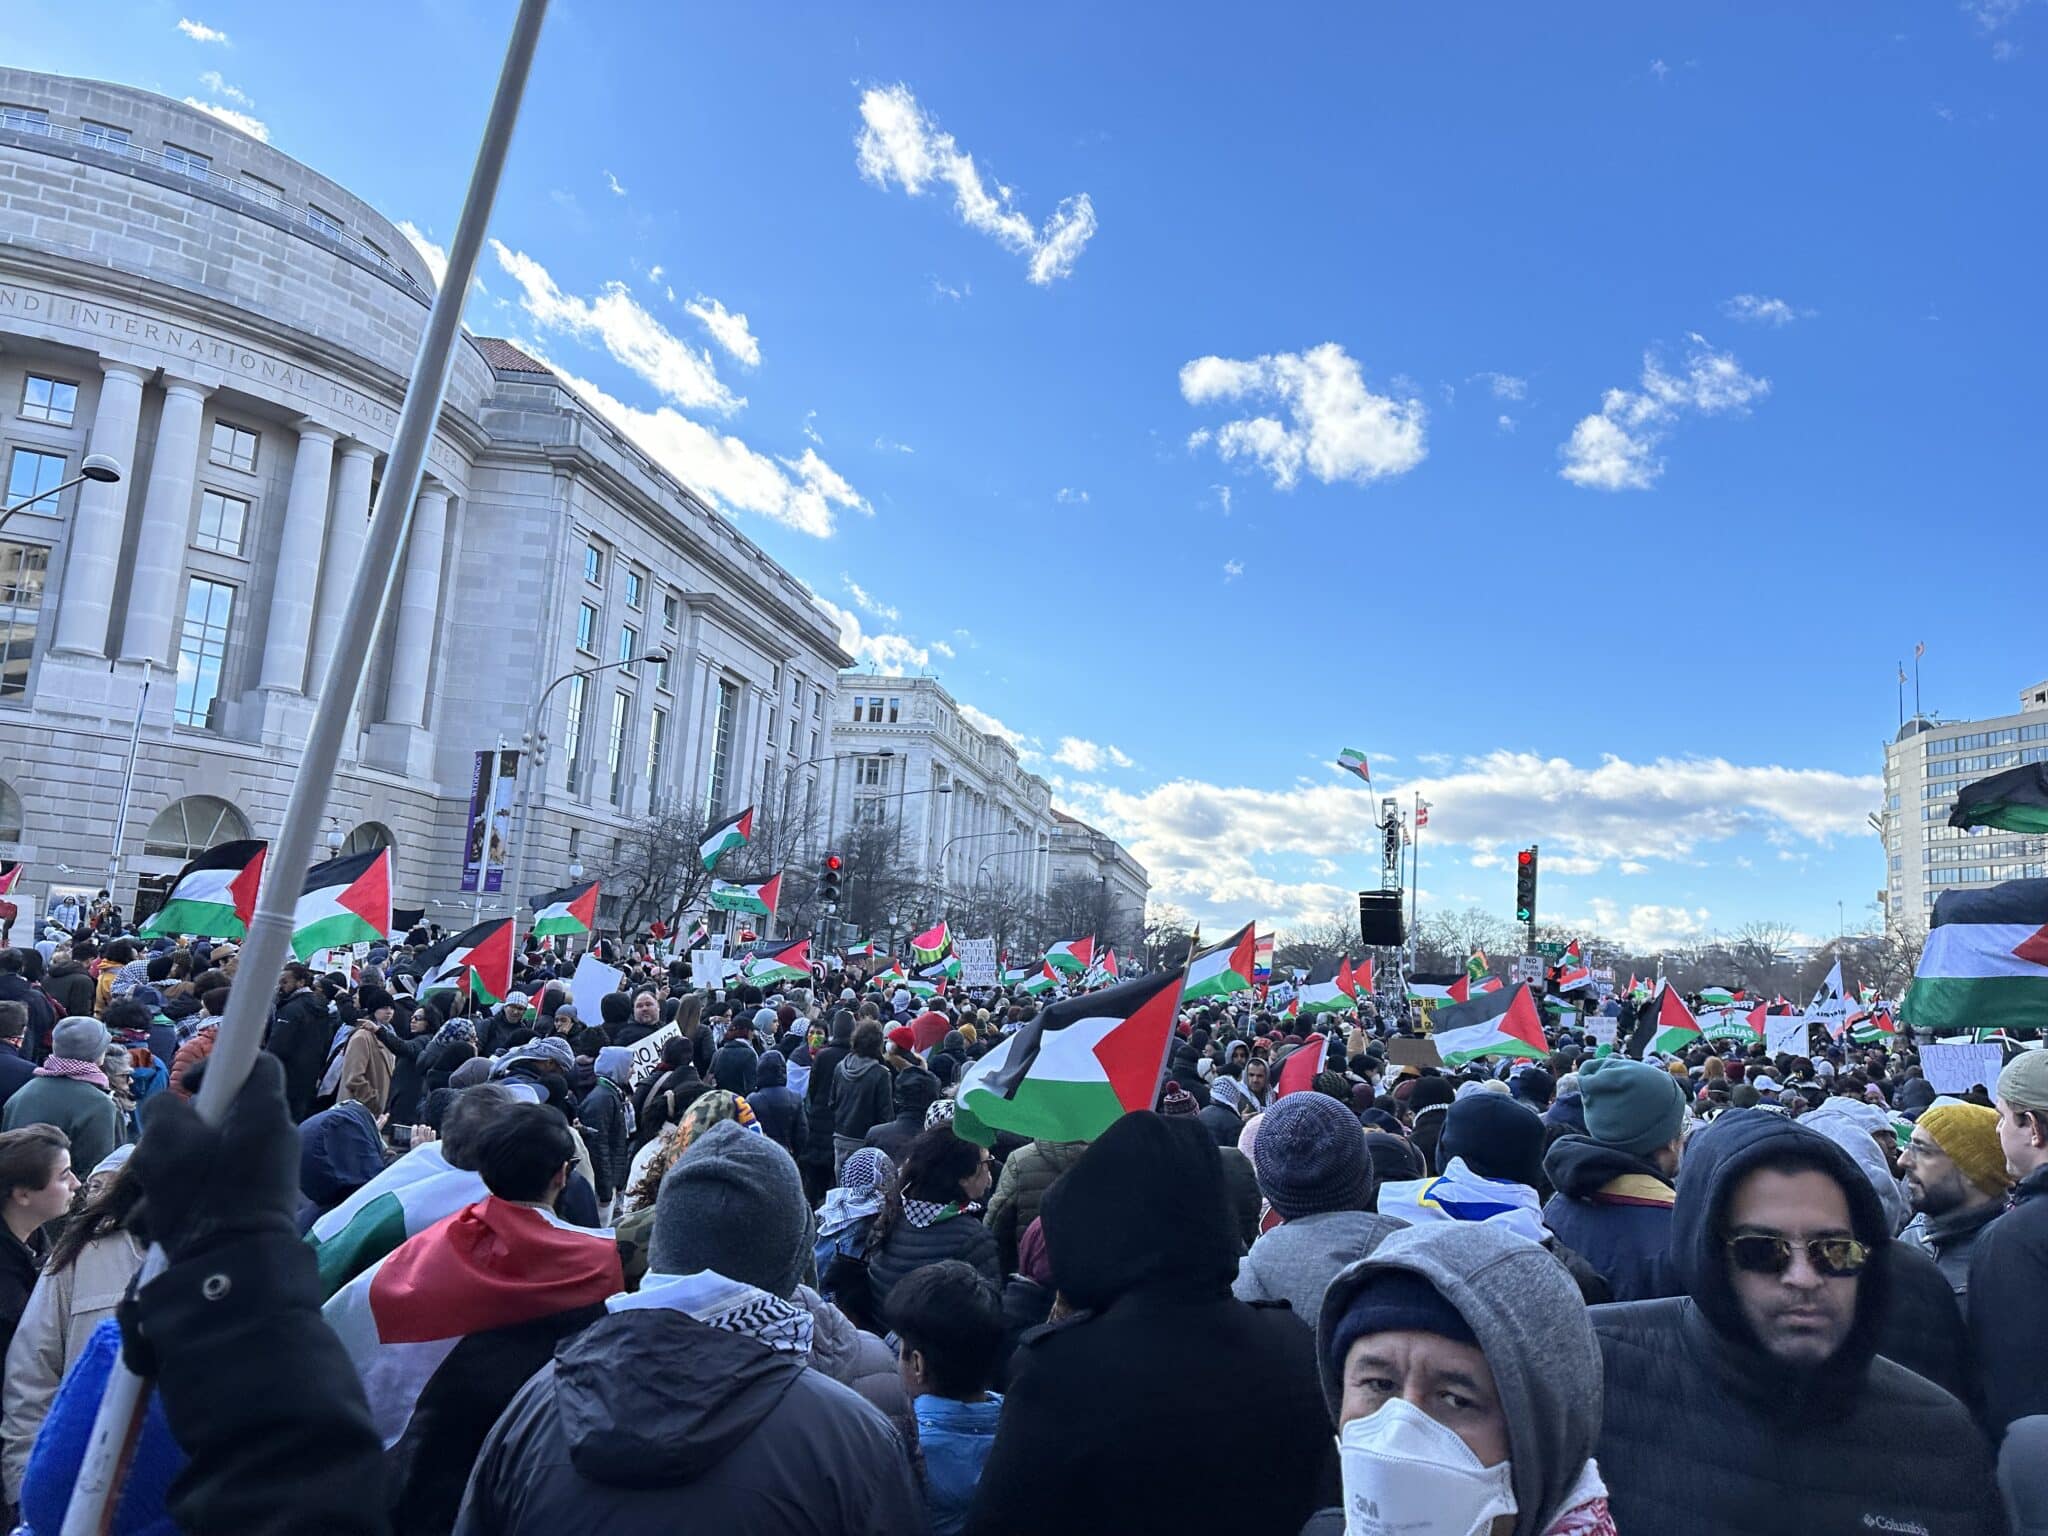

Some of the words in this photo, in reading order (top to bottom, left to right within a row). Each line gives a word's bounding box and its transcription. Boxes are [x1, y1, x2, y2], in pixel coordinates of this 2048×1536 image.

[70, 304, 310, 391] INTERNATIONAL
[330, 386, 393, 428] TRADE
[632, 1047, 651, 1067] NO
[1356, 1494, 1379, 1519] 3M
